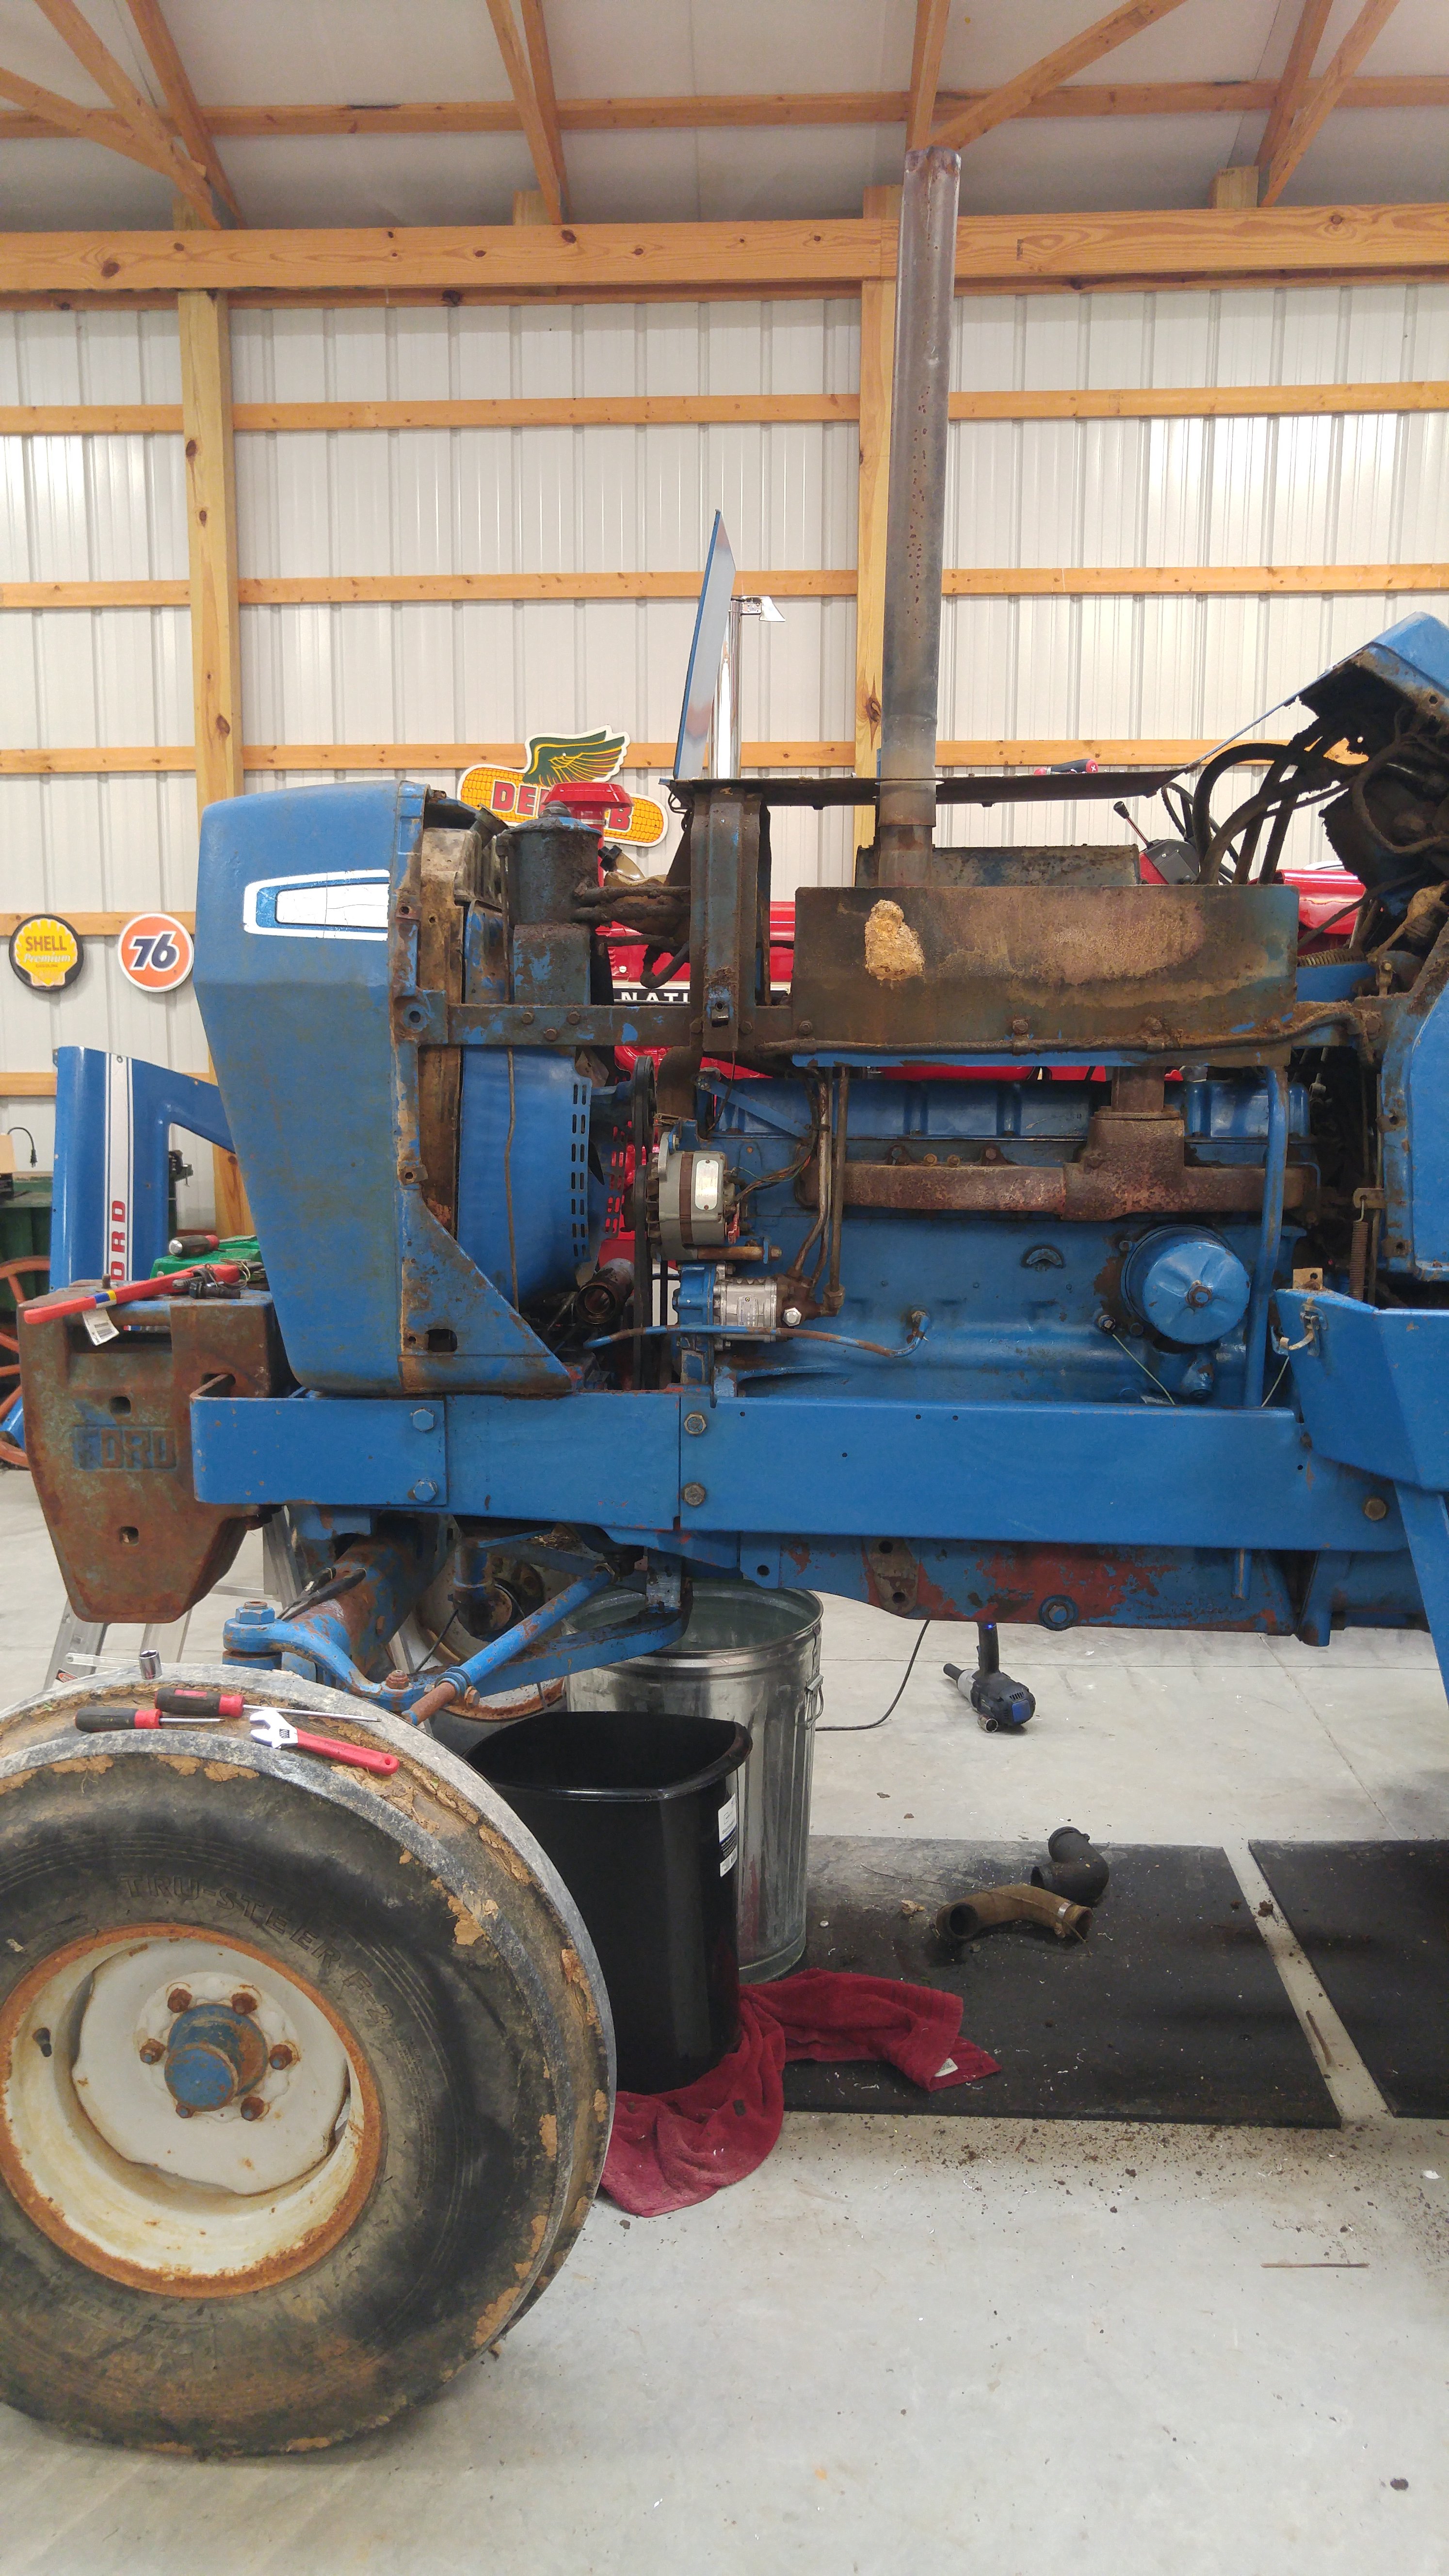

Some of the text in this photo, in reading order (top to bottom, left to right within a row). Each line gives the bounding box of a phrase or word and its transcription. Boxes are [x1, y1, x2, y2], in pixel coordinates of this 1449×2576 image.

[24, 952, 70, 963] Premium
[26, 935, 67, 951] SHELL
[130, 932, 179, 971] 76
[111, 1201, 125, 1280] ORD
[77, 1429, 176, 1468] FORD
